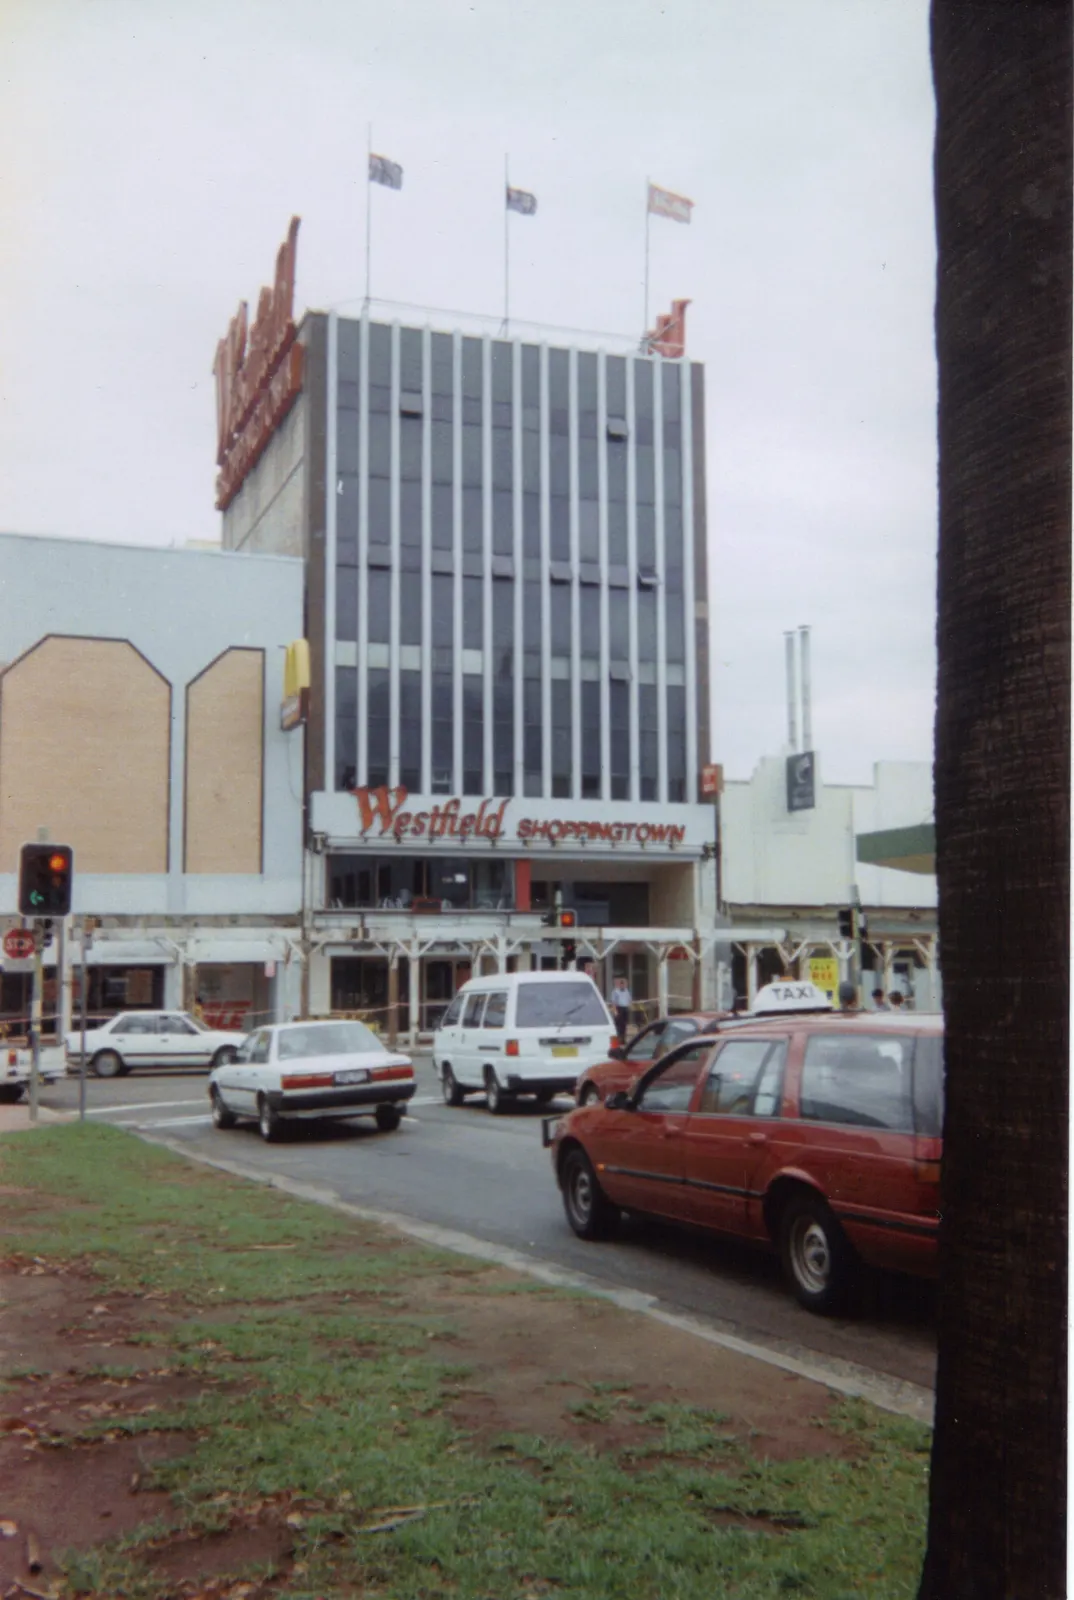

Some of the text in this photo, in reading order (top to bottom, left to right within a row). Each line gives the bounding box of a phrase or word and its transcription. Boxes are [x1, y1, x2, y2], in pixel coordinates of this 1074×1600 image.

[350, 784, 686, 842] Westfield SHOPPINGTOWN
[6, 938, 34, 950] STOP
[771, 986, 816, 1000] TAXI
